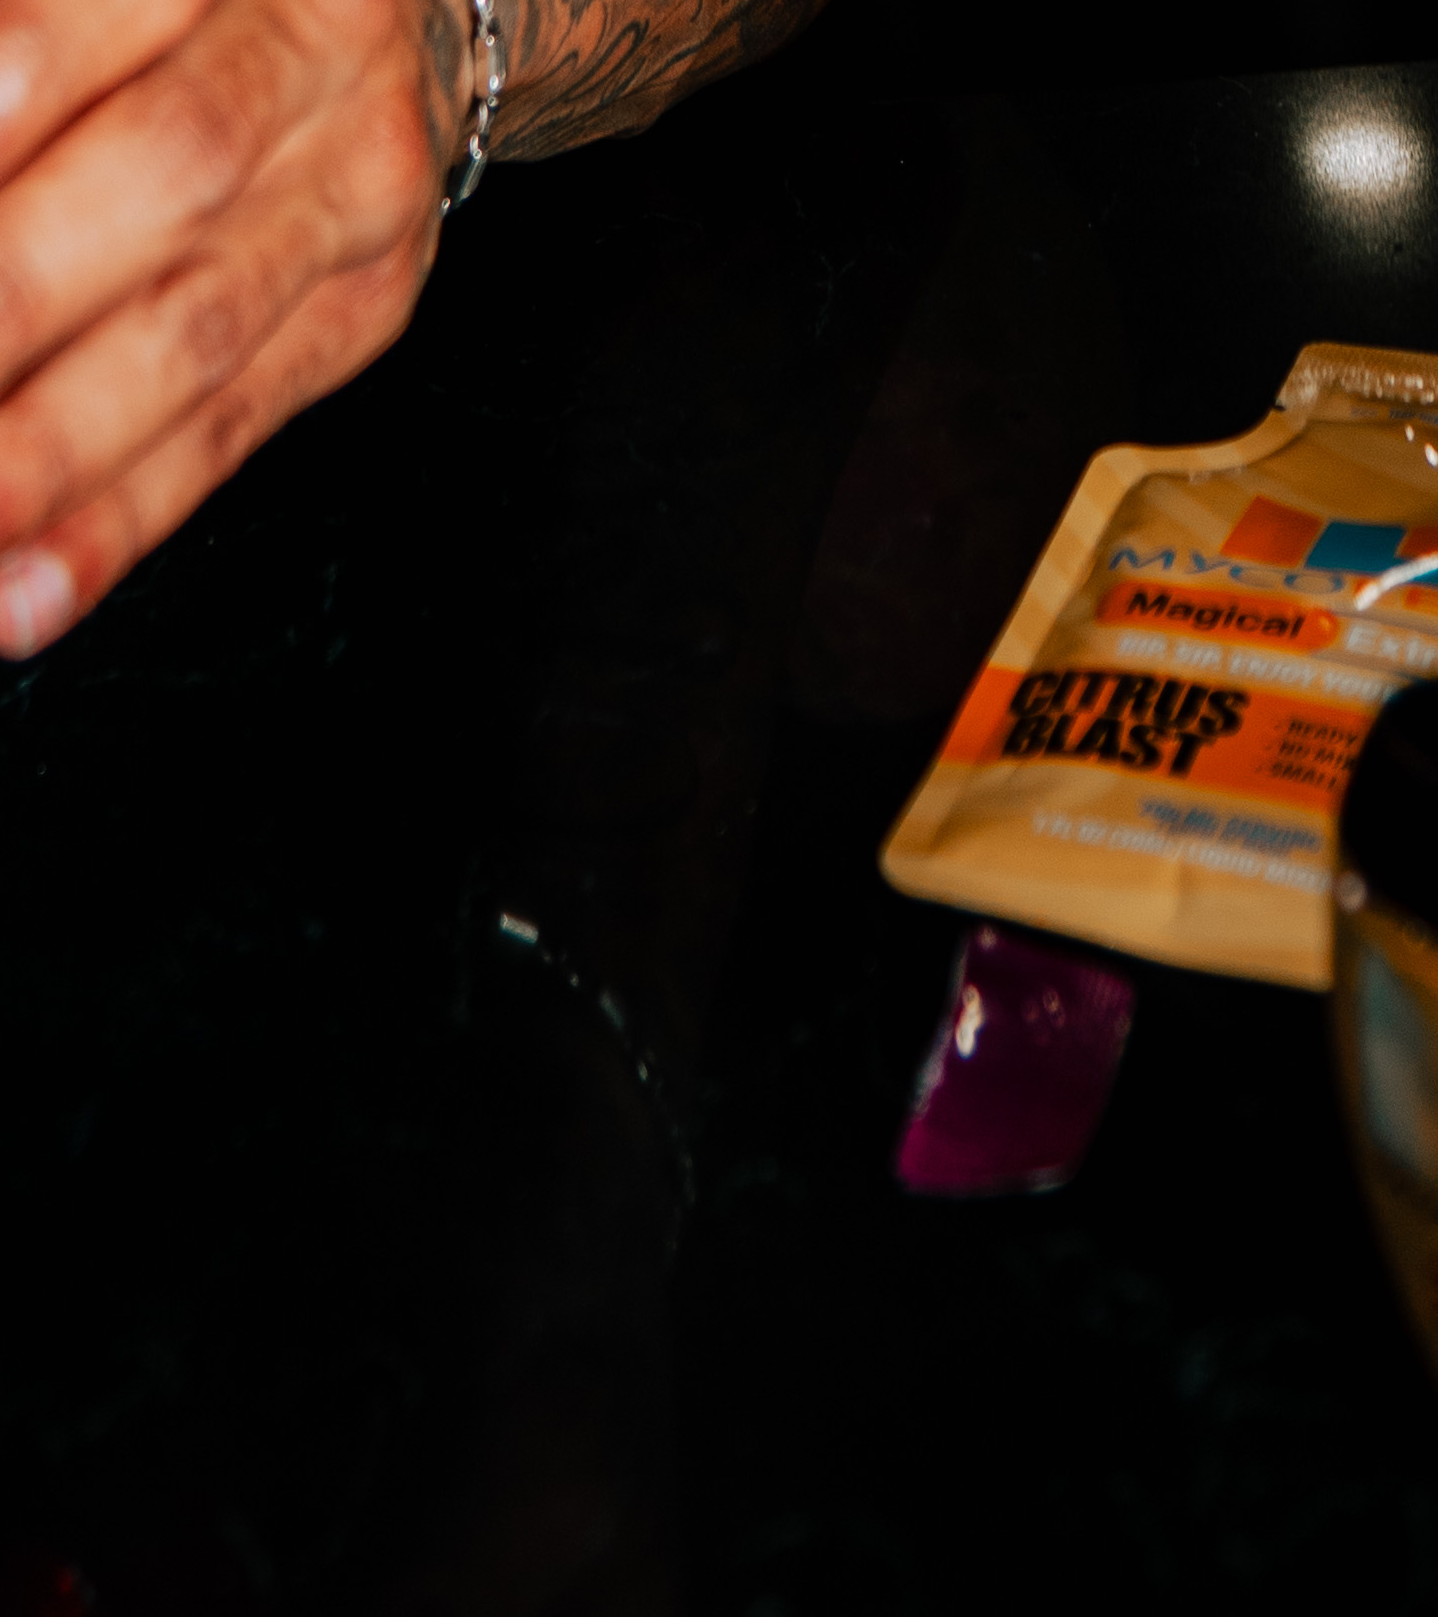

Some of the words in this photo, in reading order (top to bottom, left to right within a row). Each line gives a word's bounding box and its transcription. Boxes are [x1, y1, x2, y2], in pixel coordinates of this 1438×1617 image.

[1126, 588, 1307, 641] Magical
[1228, 651, 1319, 687] ENJOY
[1007, 668, 1253, 742] CITRUS
[1000, 715, 1218, 778] BLAST
